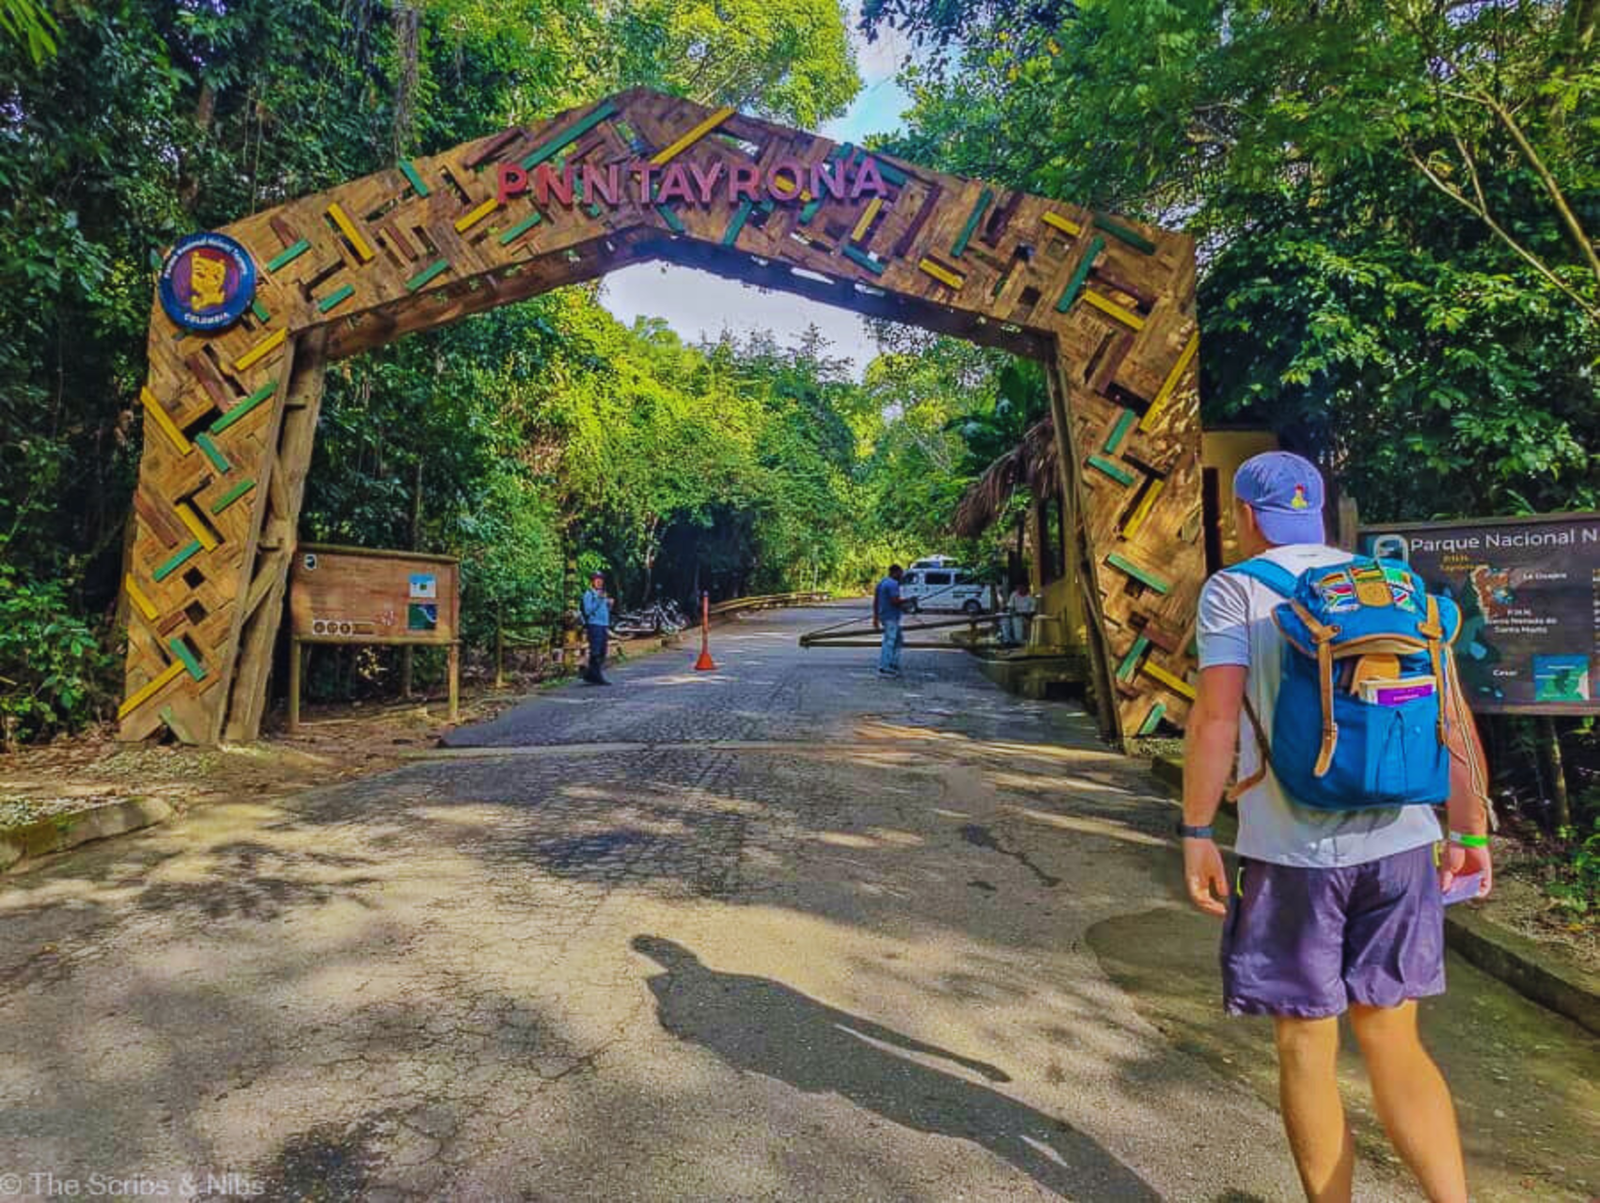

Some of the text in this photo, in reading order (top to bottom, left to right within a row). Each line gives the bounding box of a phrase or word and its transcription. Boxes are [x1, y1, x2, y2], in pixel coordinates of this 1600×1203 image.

[498, 157, 888, 206] PNN TAYRONA
[184, 312, 230, 325] COLOMBIA
[1410, 536, 1480, 553] Parque
[1485, 529, 1575, 548] Nacional
